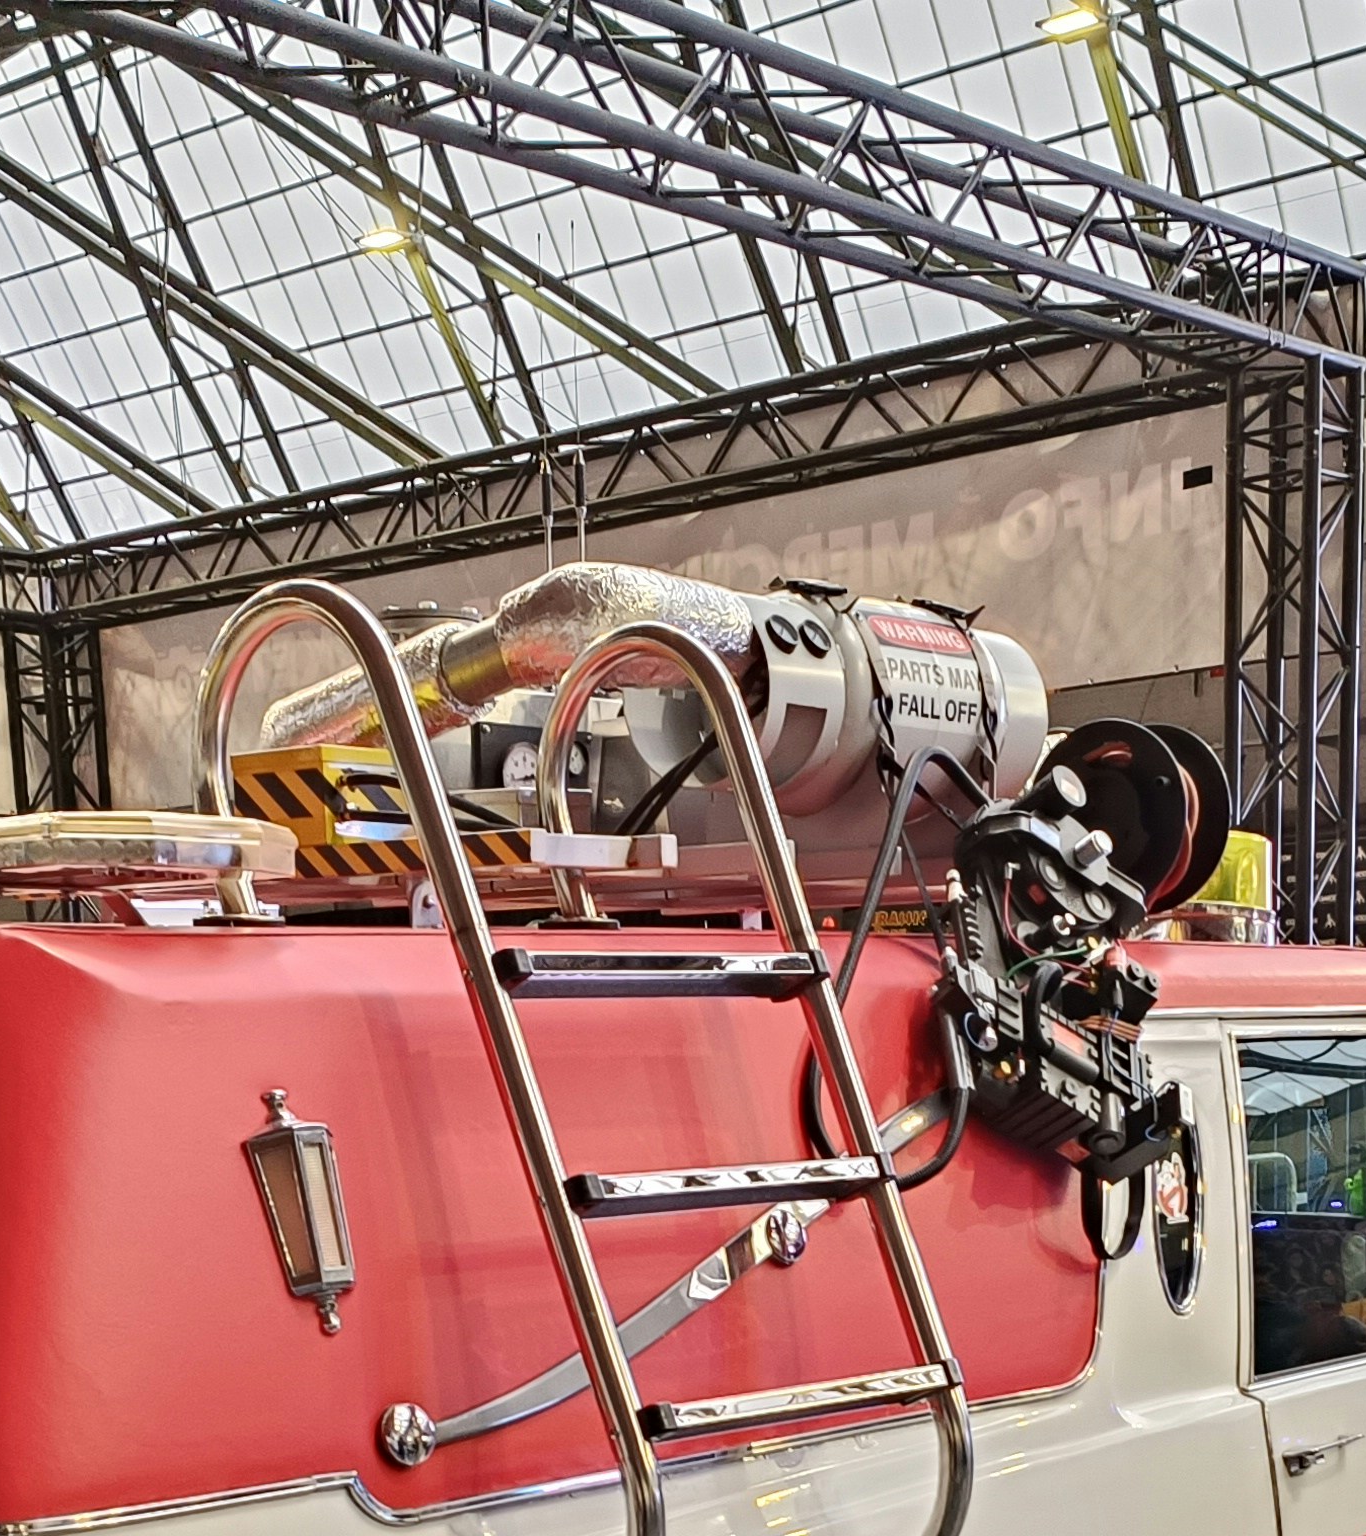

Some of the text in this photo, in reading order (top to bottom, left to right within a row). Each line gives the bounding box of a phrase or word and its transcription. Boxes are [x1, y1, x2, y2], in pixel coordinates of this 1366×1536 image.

[873, 618, 966, 650] WARNING
[886, 656, 945, 687] PARTS
[899, 693, 978, 725] FALL OFF
